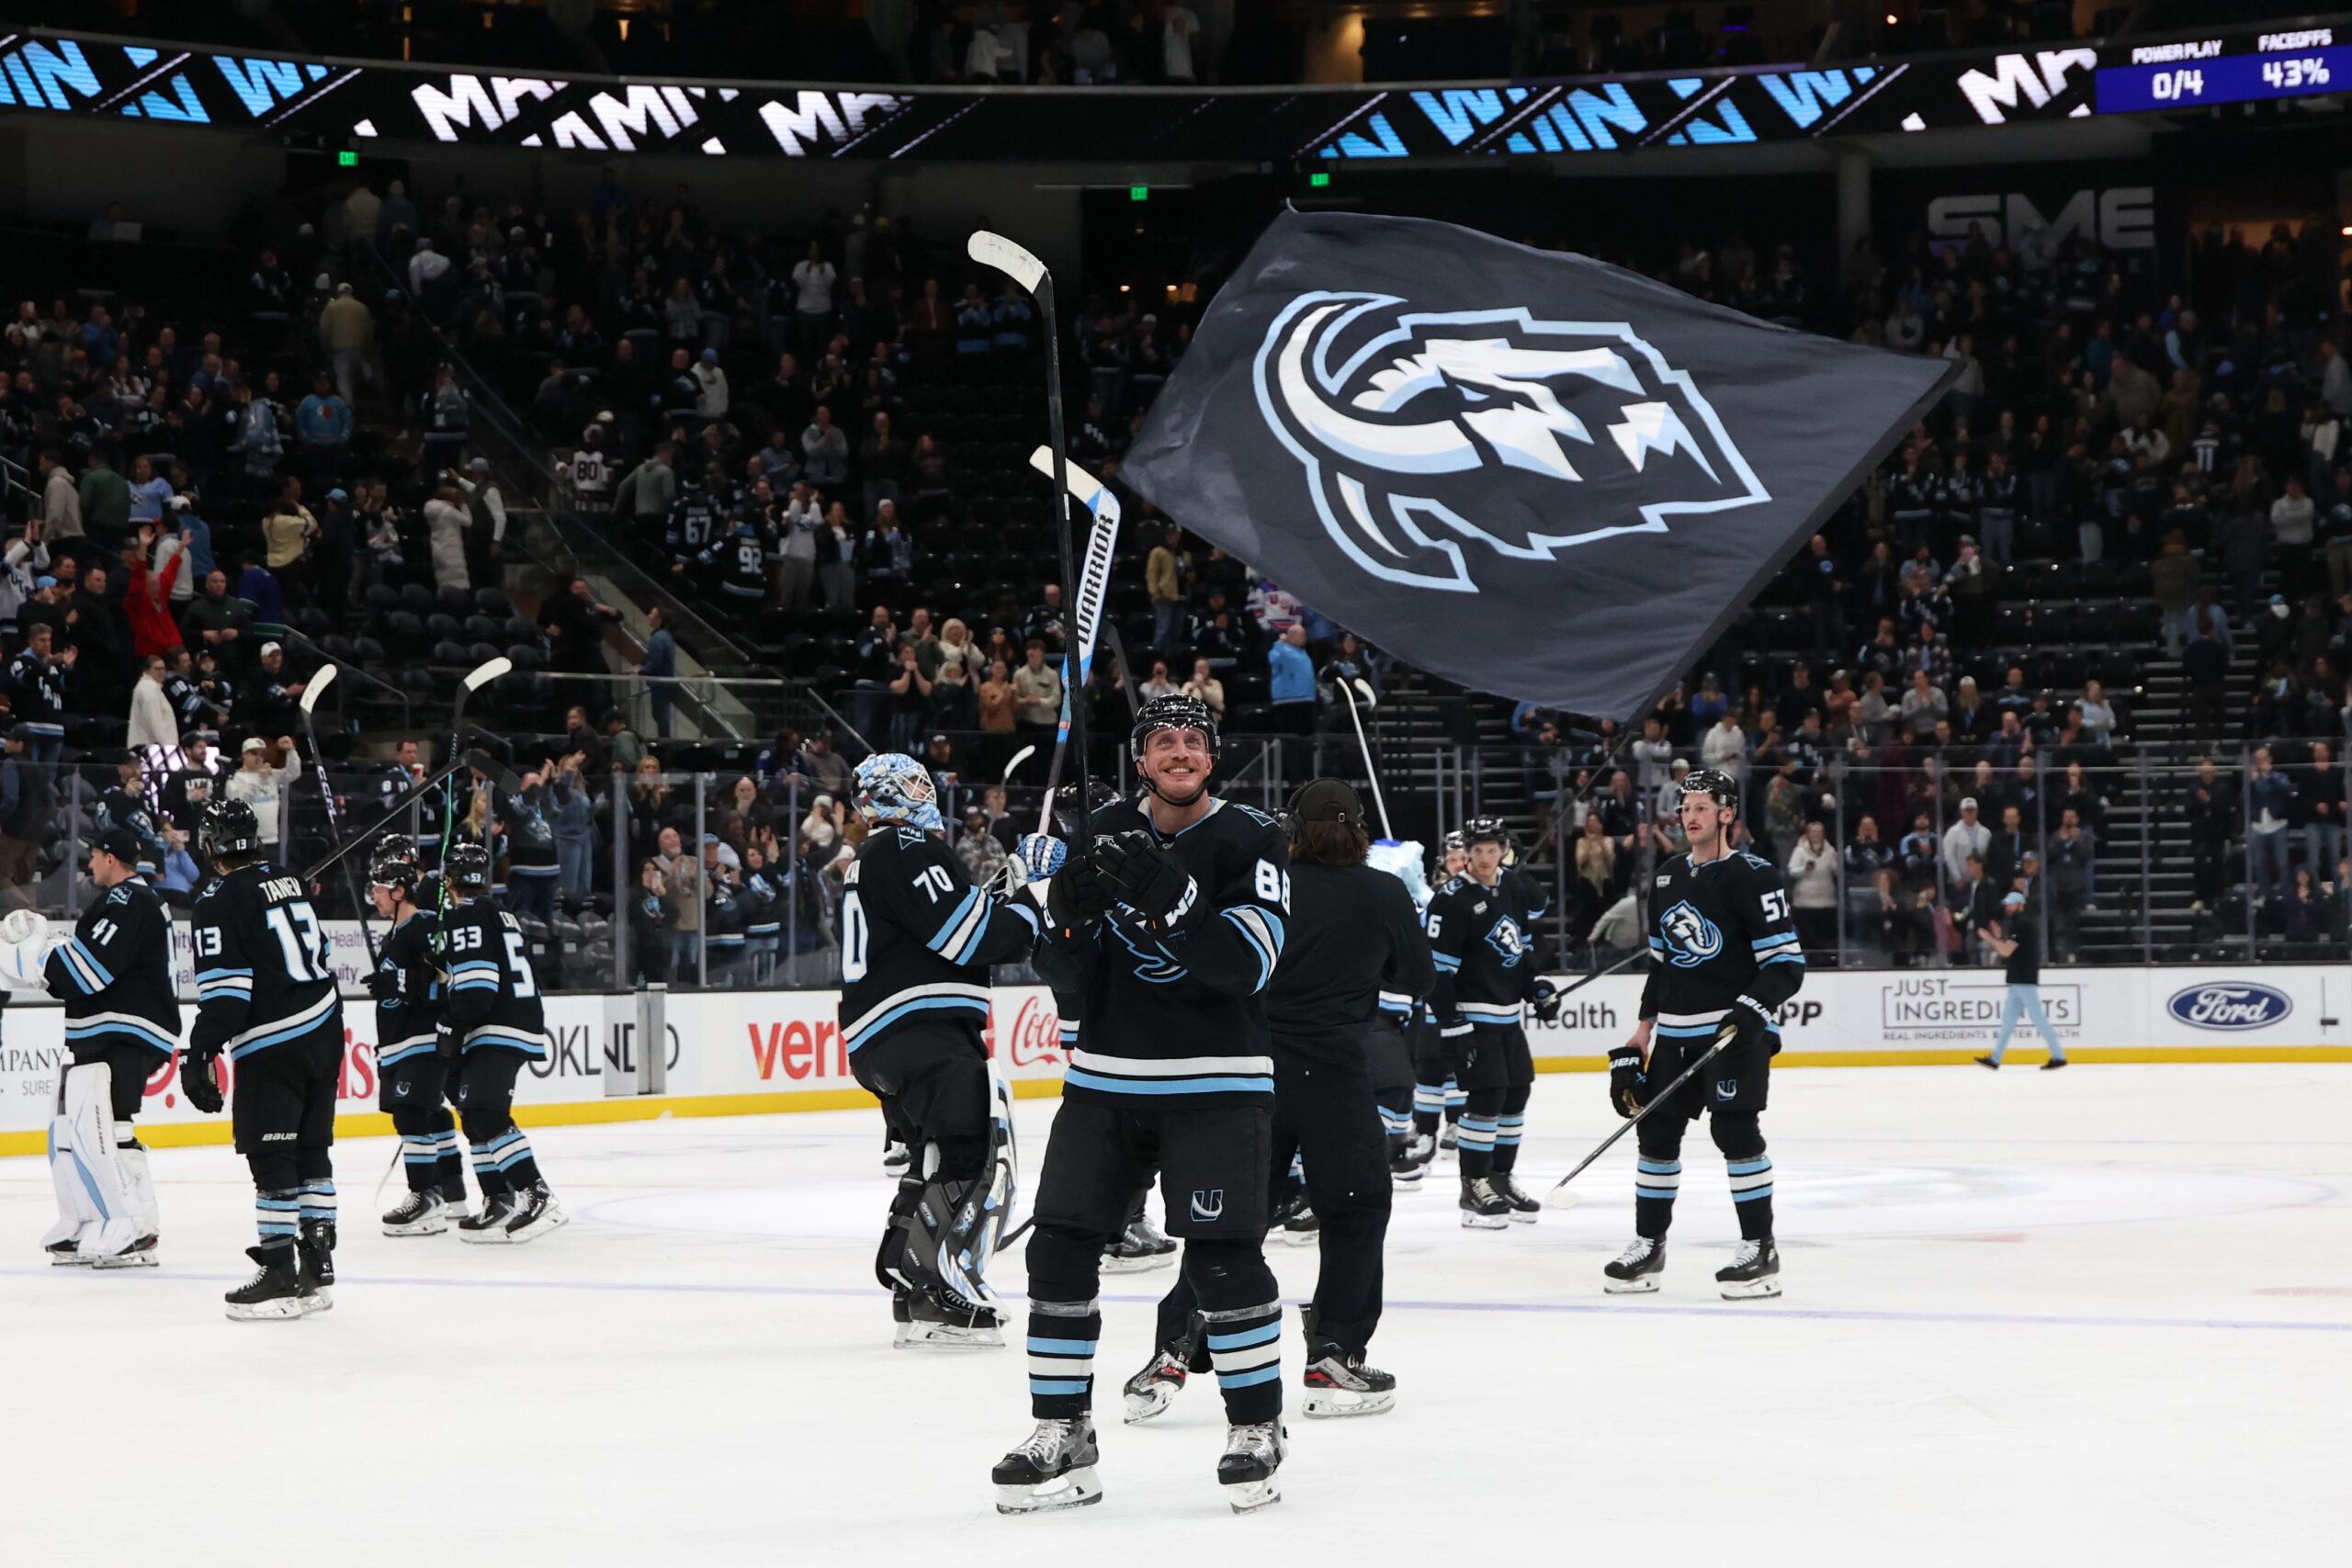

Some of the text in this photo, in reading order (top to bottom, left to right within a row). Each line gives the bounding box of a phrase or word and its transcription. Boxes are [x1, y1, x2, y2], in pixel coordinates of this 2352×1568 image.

[2132, 39, 2222, 64] POWER PLAY
[2258, 28, 2333, 52] FACEOFFS
[2152, 69, 2204, 100] 0/4
[2262, 57, 2330, 89] 43%
[1928, 186, 2155, 258] SME
[576, 460, 597, 481] 80
[685, 515, 712, 544] 67
[739, 546, 763, 574] 92
[1078, 513, 1114, 646] WARRIOR
[236, 838, 247, 851] 13
[258, 876, 303, 903] TANEV
[469, 873, 481, 884] 53
[911, 864, 956, 905] 70
[92, 918, 119, 946] 41
[194, 926, 222, 958] 13
[452, 925, 482, 952] 53
[502, 931, 536, 998] 5
[1894, 978, 1950, 997] JUST
[1896, 998, 2069, 1021] INGREDITS
[2188, 987, 2271, 1023] Ford
[1883, 1030, 1911, 1041] REAL
[1914, 1029, 1988, 1041] INGREDIENTS
[22, 1079, 54, 1096] SURE
